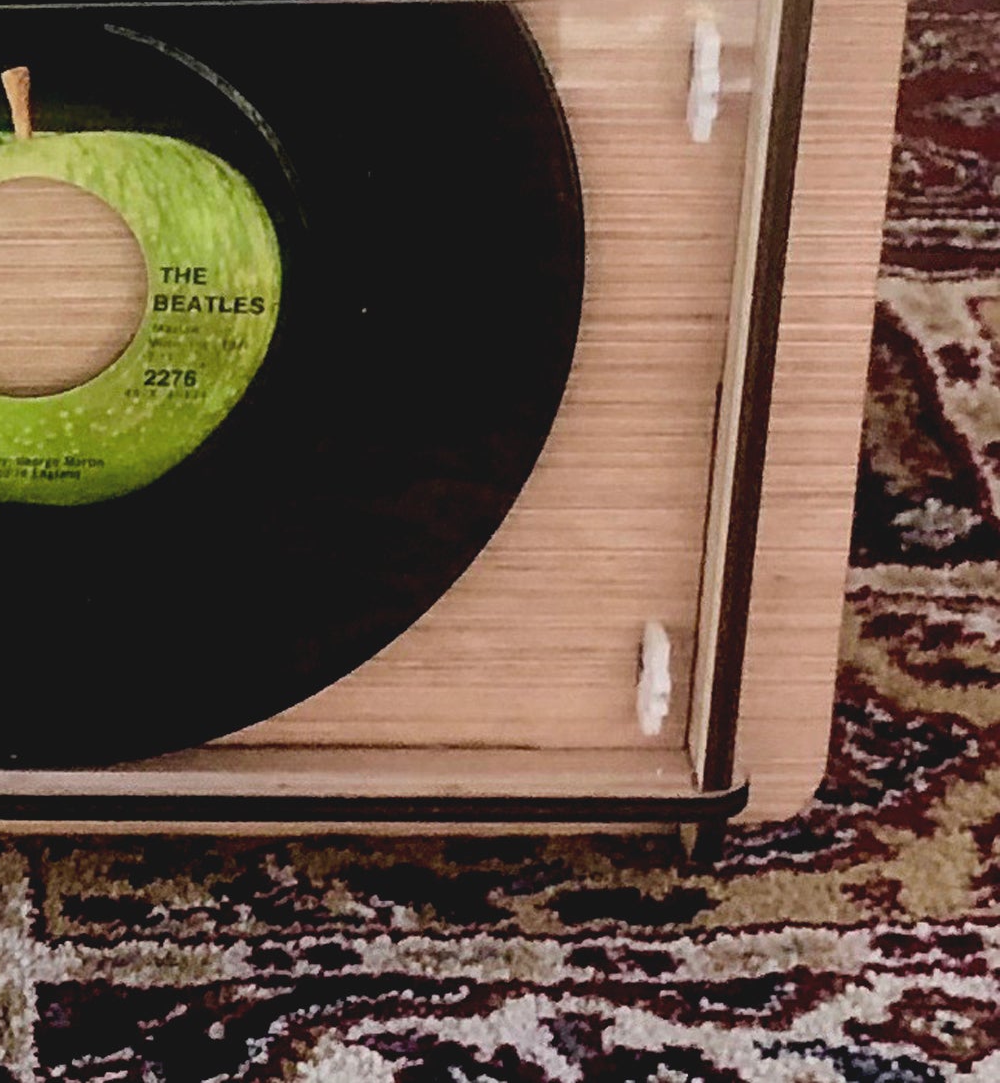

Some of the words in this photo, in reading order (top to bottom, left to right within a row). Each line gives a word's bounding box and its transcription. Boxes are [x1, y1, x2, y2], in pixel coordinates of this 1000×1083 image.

[160, 266, 208, 285] THE
[152, 294, 266, 316] BEATLES
[143, 368, 198, 388] 2276
